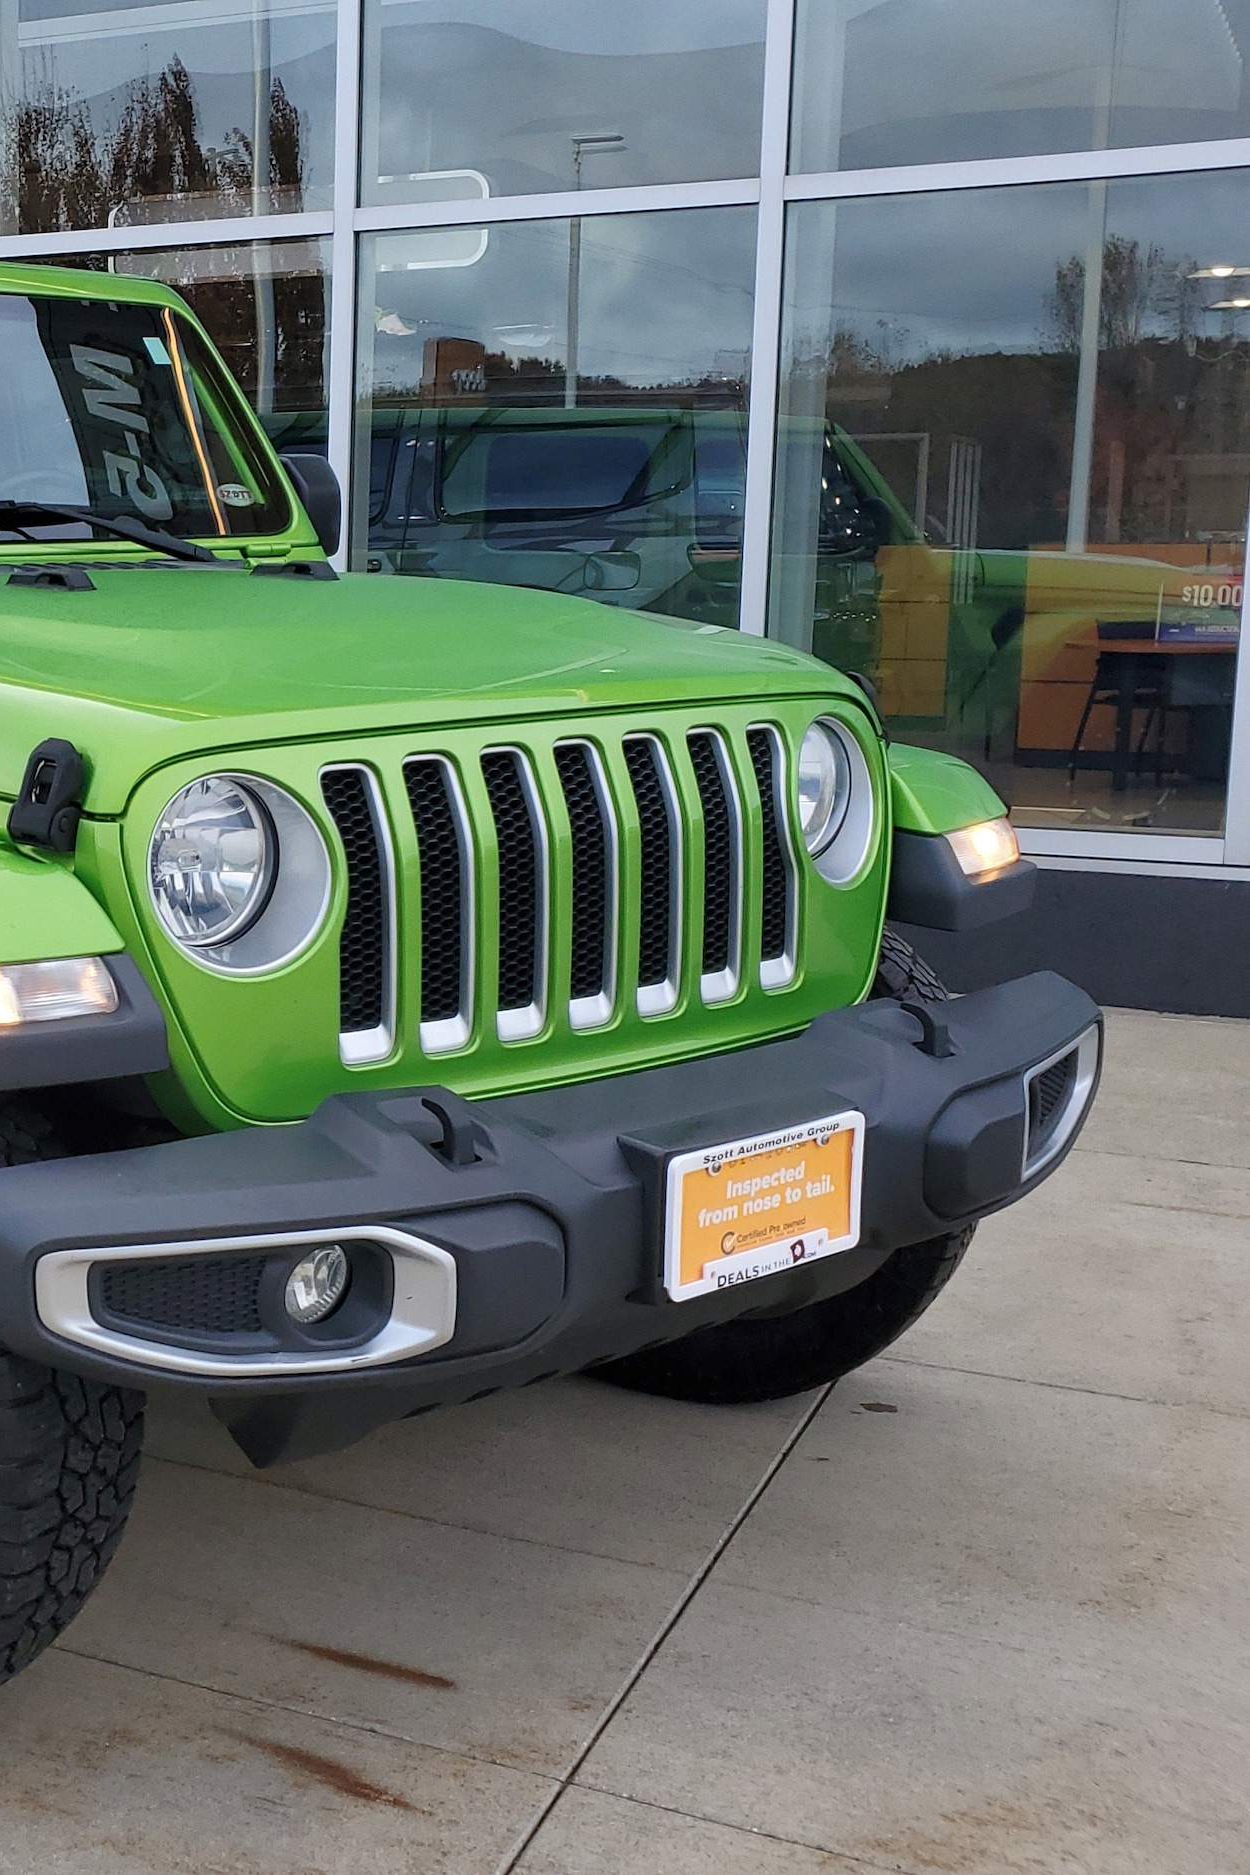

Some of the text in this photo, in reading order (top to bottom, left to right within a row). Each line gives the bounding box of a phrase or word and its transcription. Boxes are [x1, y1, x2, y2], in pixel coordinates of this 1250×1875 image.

[703, 1149, 733, 1164] Szott
[738, 1132, 803, 1155] Automotive
[807, 1122, 840, 1137] Group
[726, 1160, 805, 1199] Inspected
[698, 1174, 835, 1228] from nose to tail.
[717, 1265, 759, 1288] DEALS
